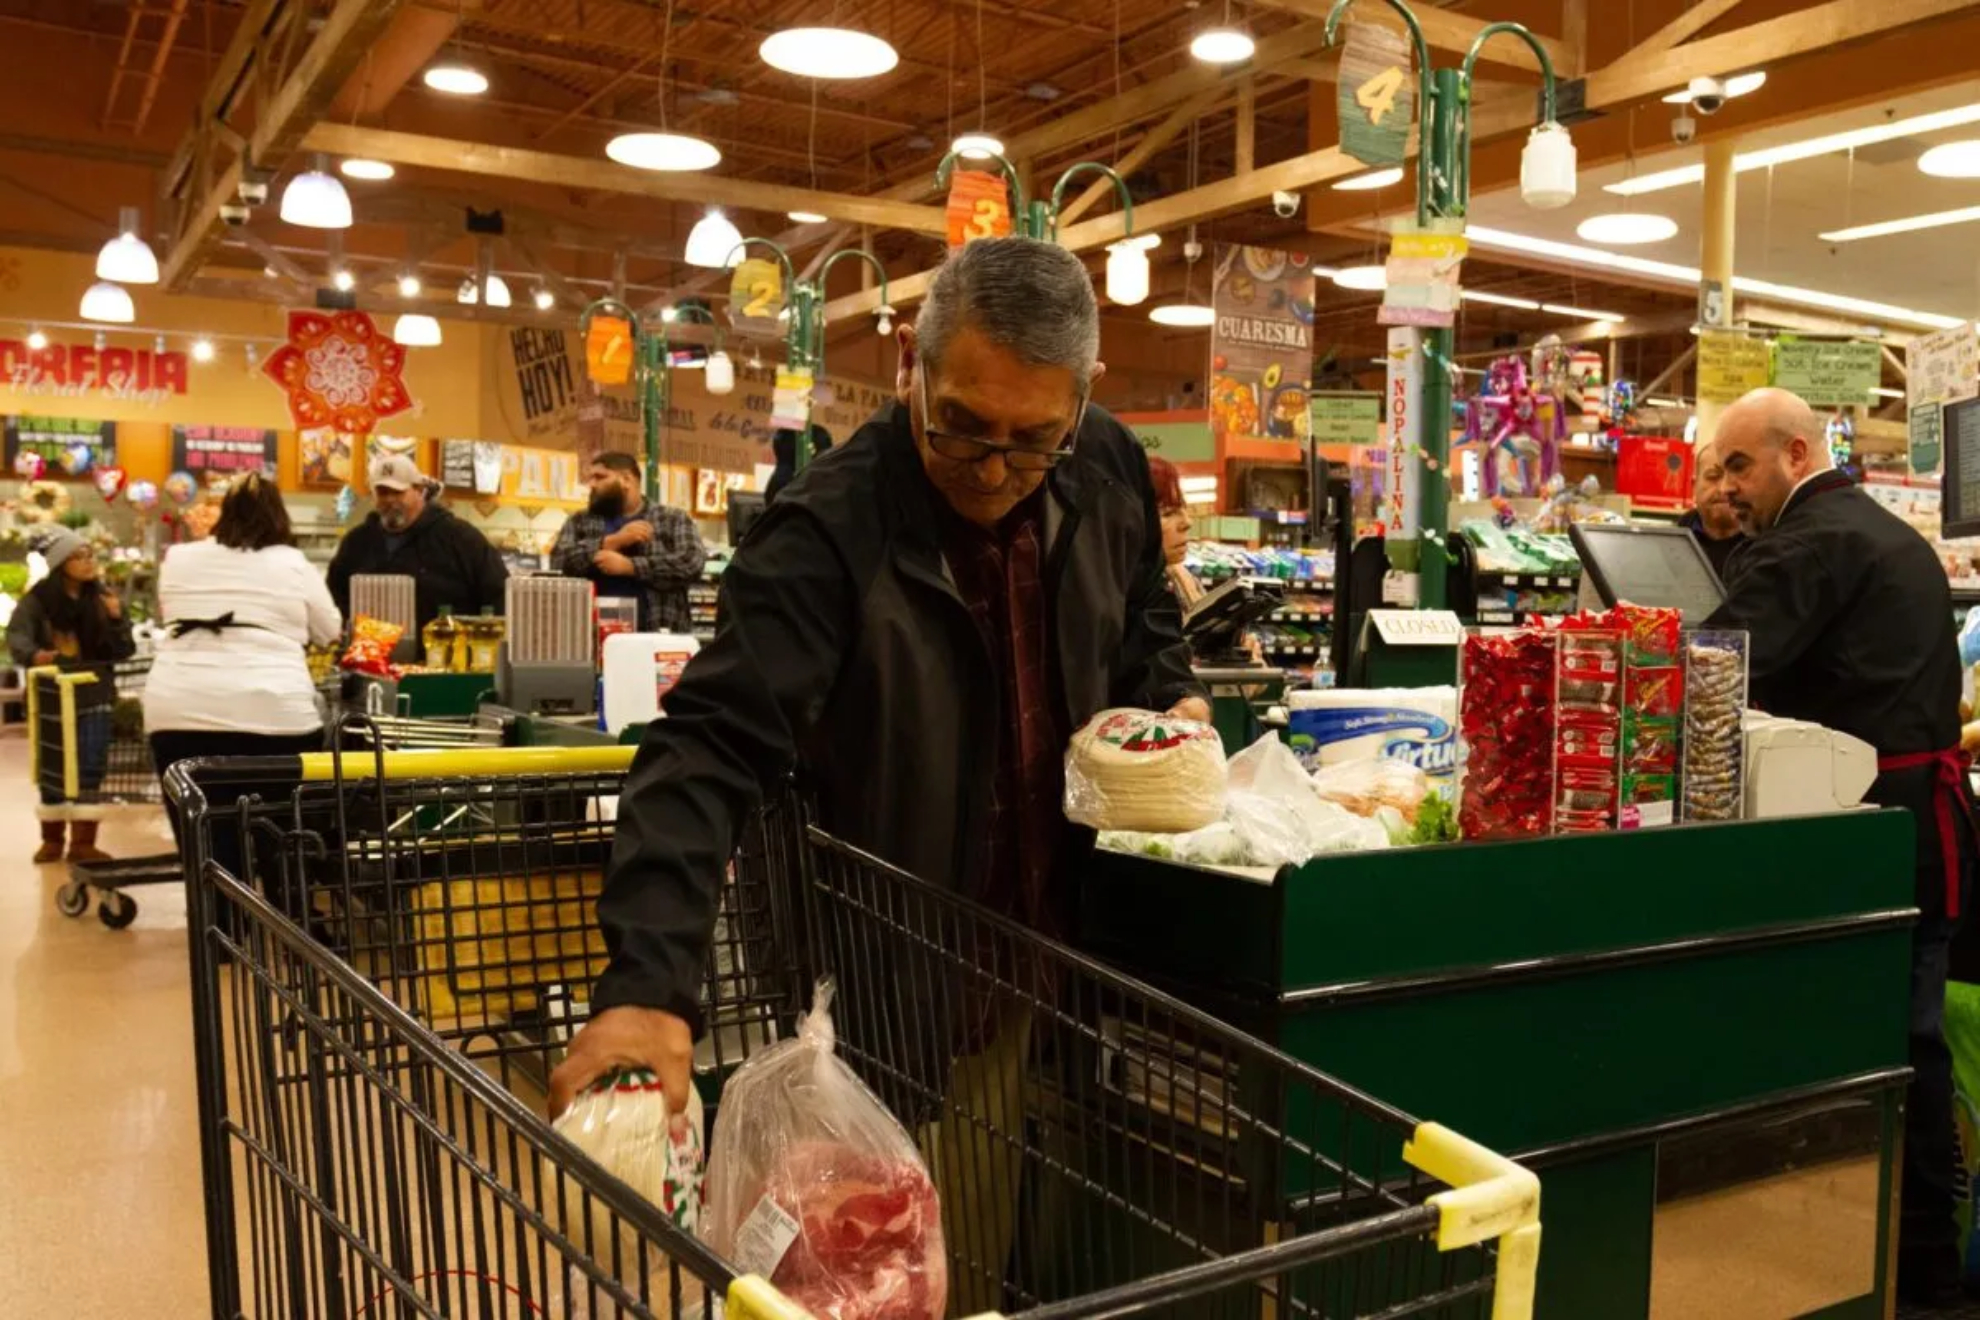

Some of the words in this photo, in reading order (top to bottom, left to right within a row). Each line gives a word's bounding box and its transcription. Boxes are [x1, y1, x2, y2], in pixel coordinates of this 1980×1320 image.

[1356, 65, 1404, 126] 4
[963, 200, 1000, 241] 3
[742, 281, 774, 317] 2
[1703, 290, 1722, 324] 5
[509, 327, 566, 370] HECHO
[602, 334, 623, 363] 1
[1218, 316, 1308, 348] CUARESMA
[1809, 374, 1847, 387] Water
[1834, 359, 1873, 372] Cream
[517, 353, 577, 420] HOY!
[1391, 378, 1406, 531] NOPALINA
[1385, 618, 1458, 635] CLOSED
